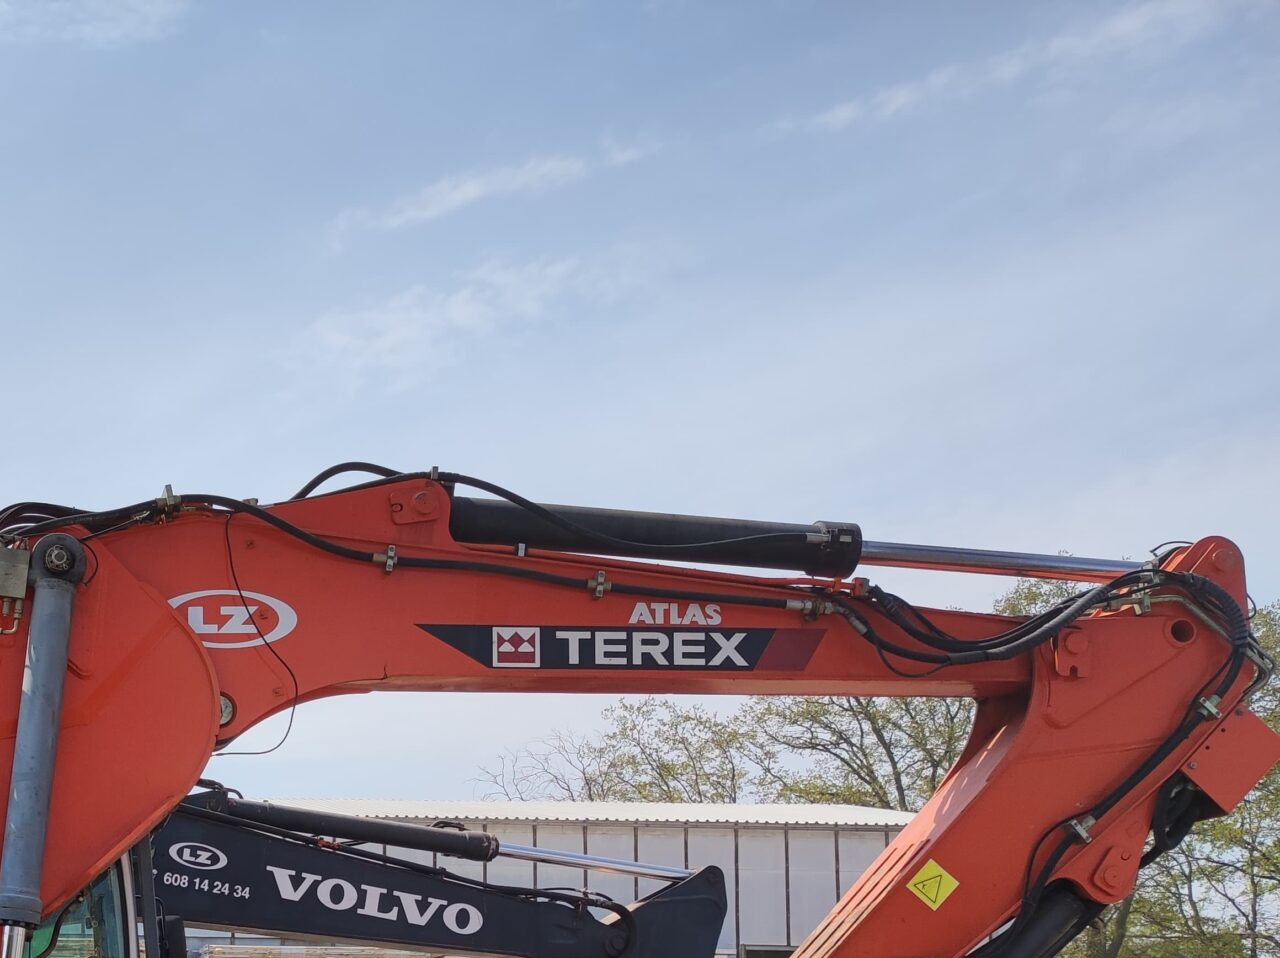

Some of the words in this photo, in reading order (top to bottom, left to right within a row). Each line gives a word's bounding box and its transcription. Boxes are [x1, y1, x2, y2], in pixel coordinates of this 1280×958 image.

[187, 606, 259, 634] LZ
[628, 602, 722, 626] ATLAS
[555, 631, 750, 667] TEREX
[182, 847, 214, 865] LZ
[163, 872, 189, 888] 608
[193, 877, 210, 892] 14
[212, 881, 230, 896] 24
[233, 884, 250, 900] 34
[266, 865, 484, 936] VOLVO
